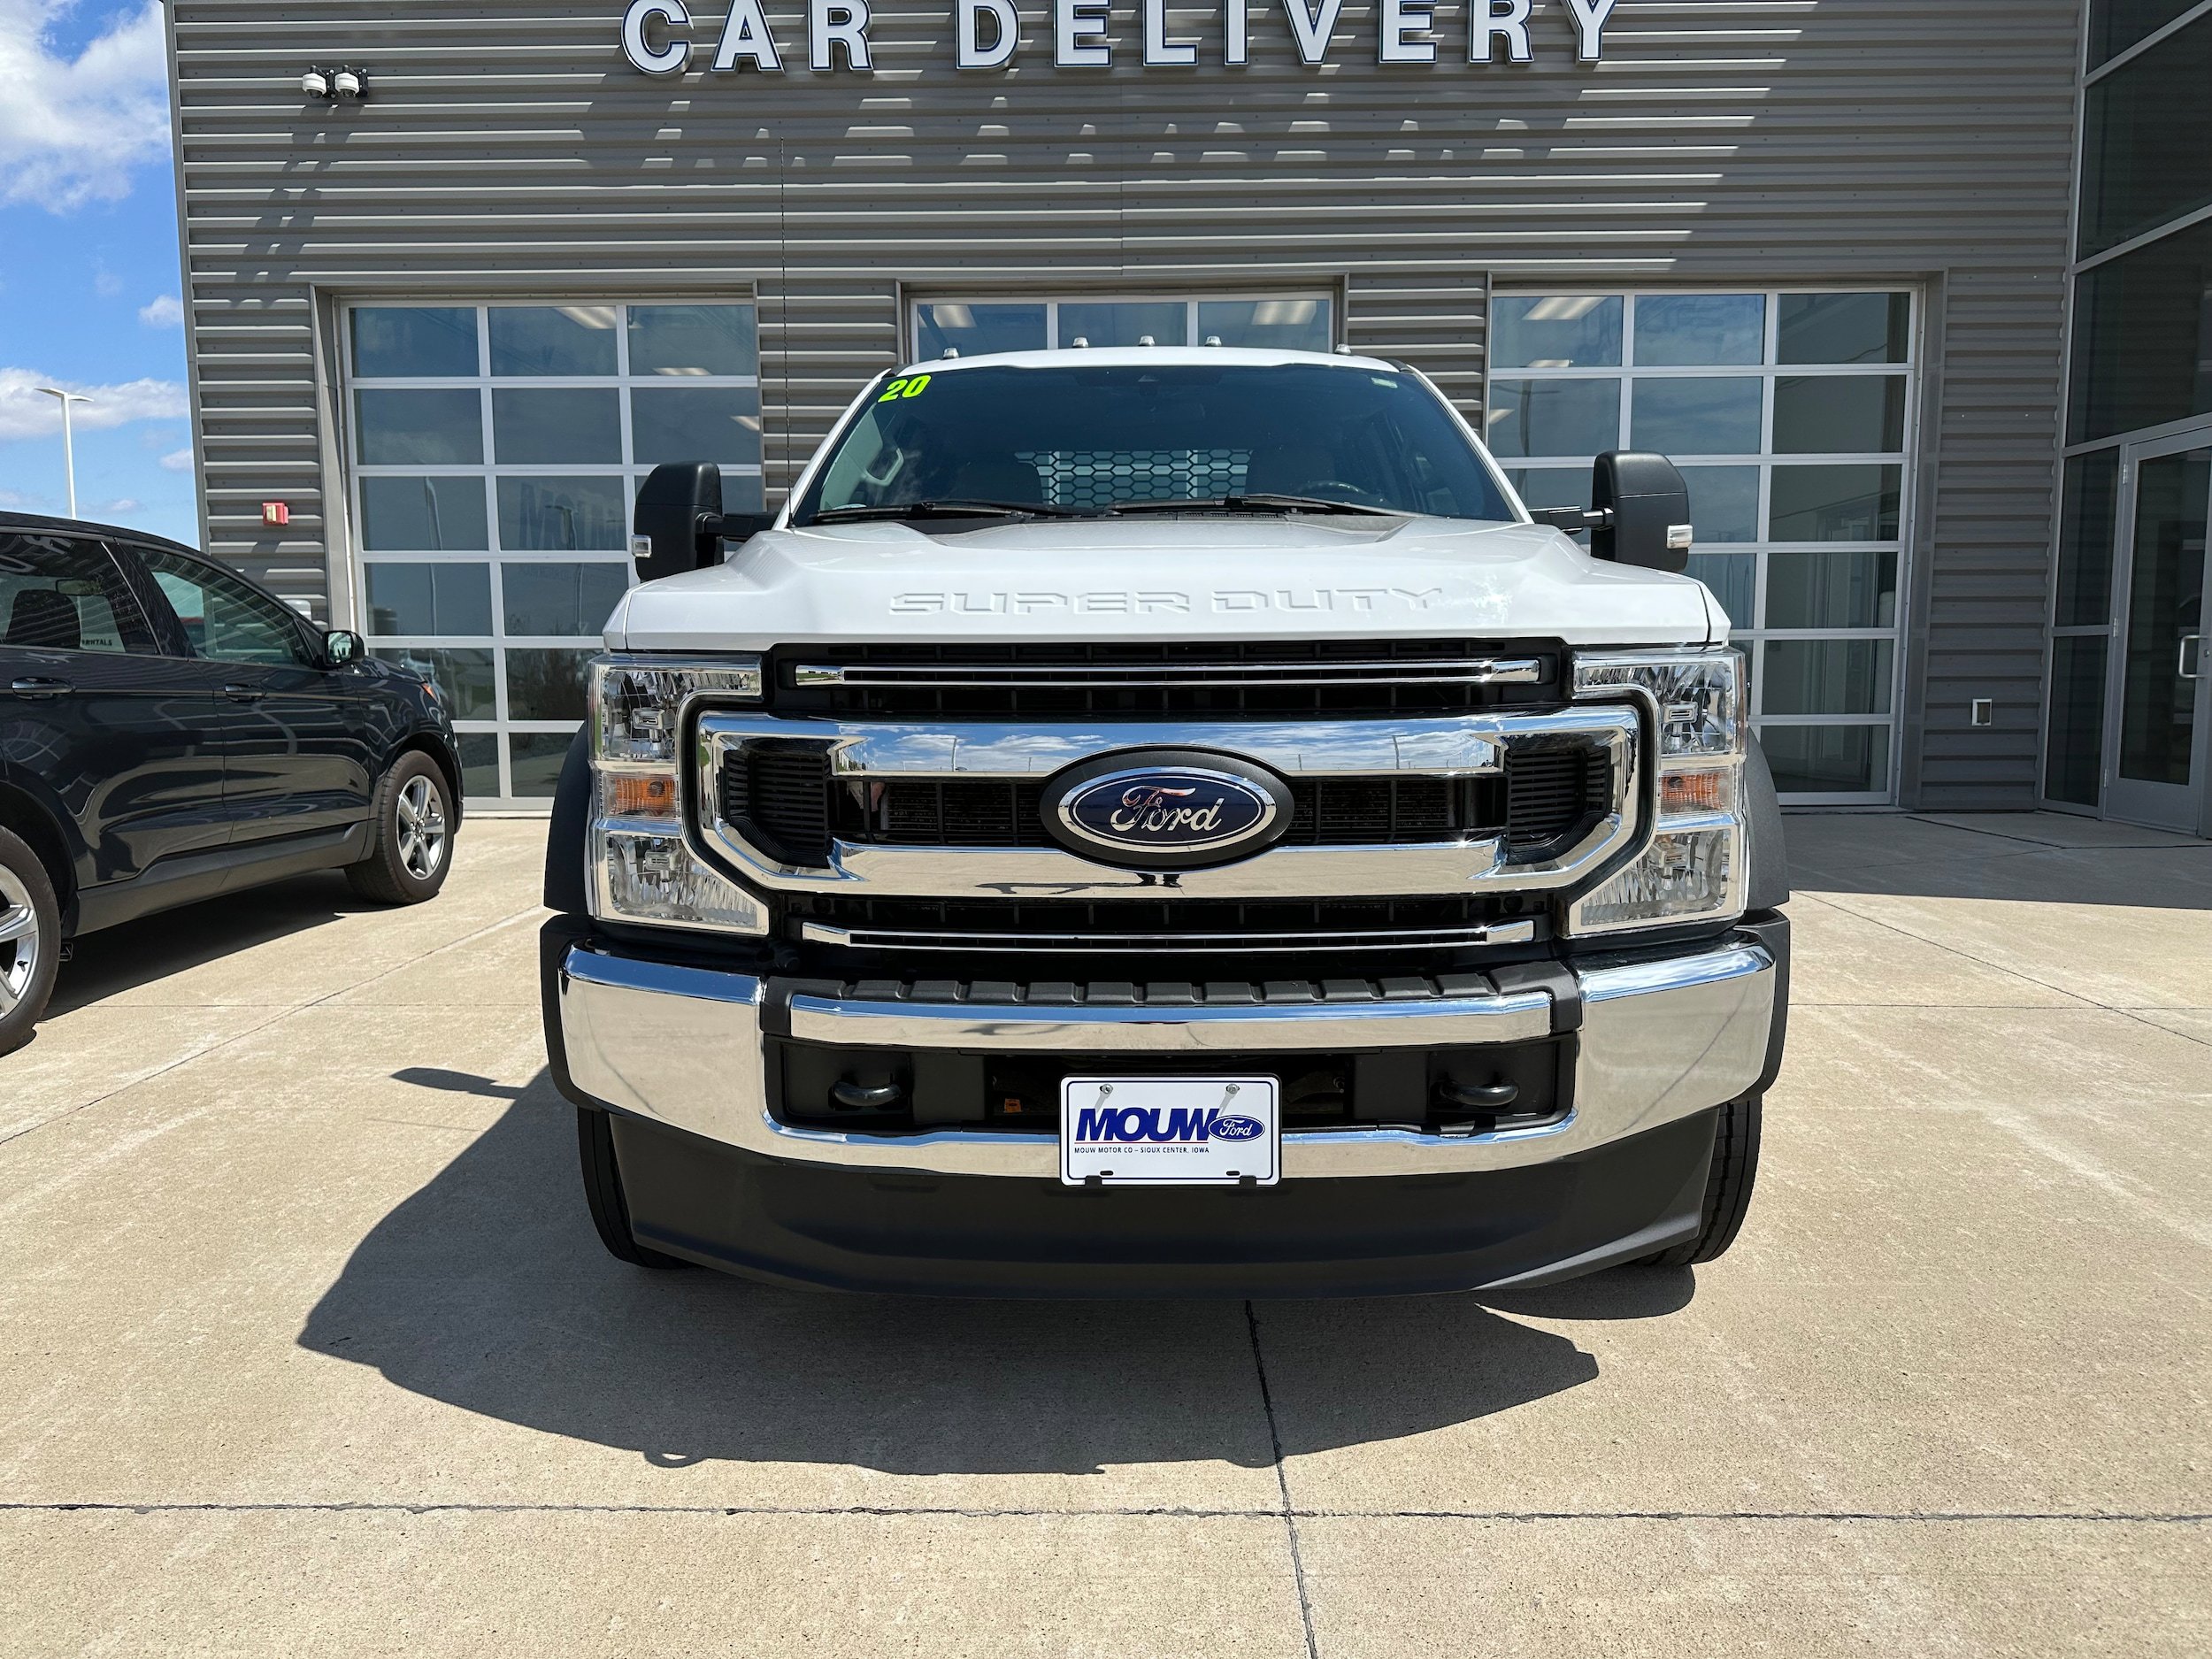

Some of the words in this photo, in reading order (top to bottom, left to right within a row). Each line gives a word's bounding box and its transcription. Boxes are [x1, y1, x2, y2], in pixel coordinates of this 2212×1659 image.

[621, 0, 874, 78] CAR
[956, 0, 1618, 71] DELIVERY
[877, 374, 932, 403] 20
[889, 592, 1190, 616] SUPER
[1210, 588, 1443, 615] DUTY
[1110, 785, 1225, 832] Ford
[1075, 1107, 1220, 1142] MOUW
[1218, 1118, 1253, 1137] Ford
